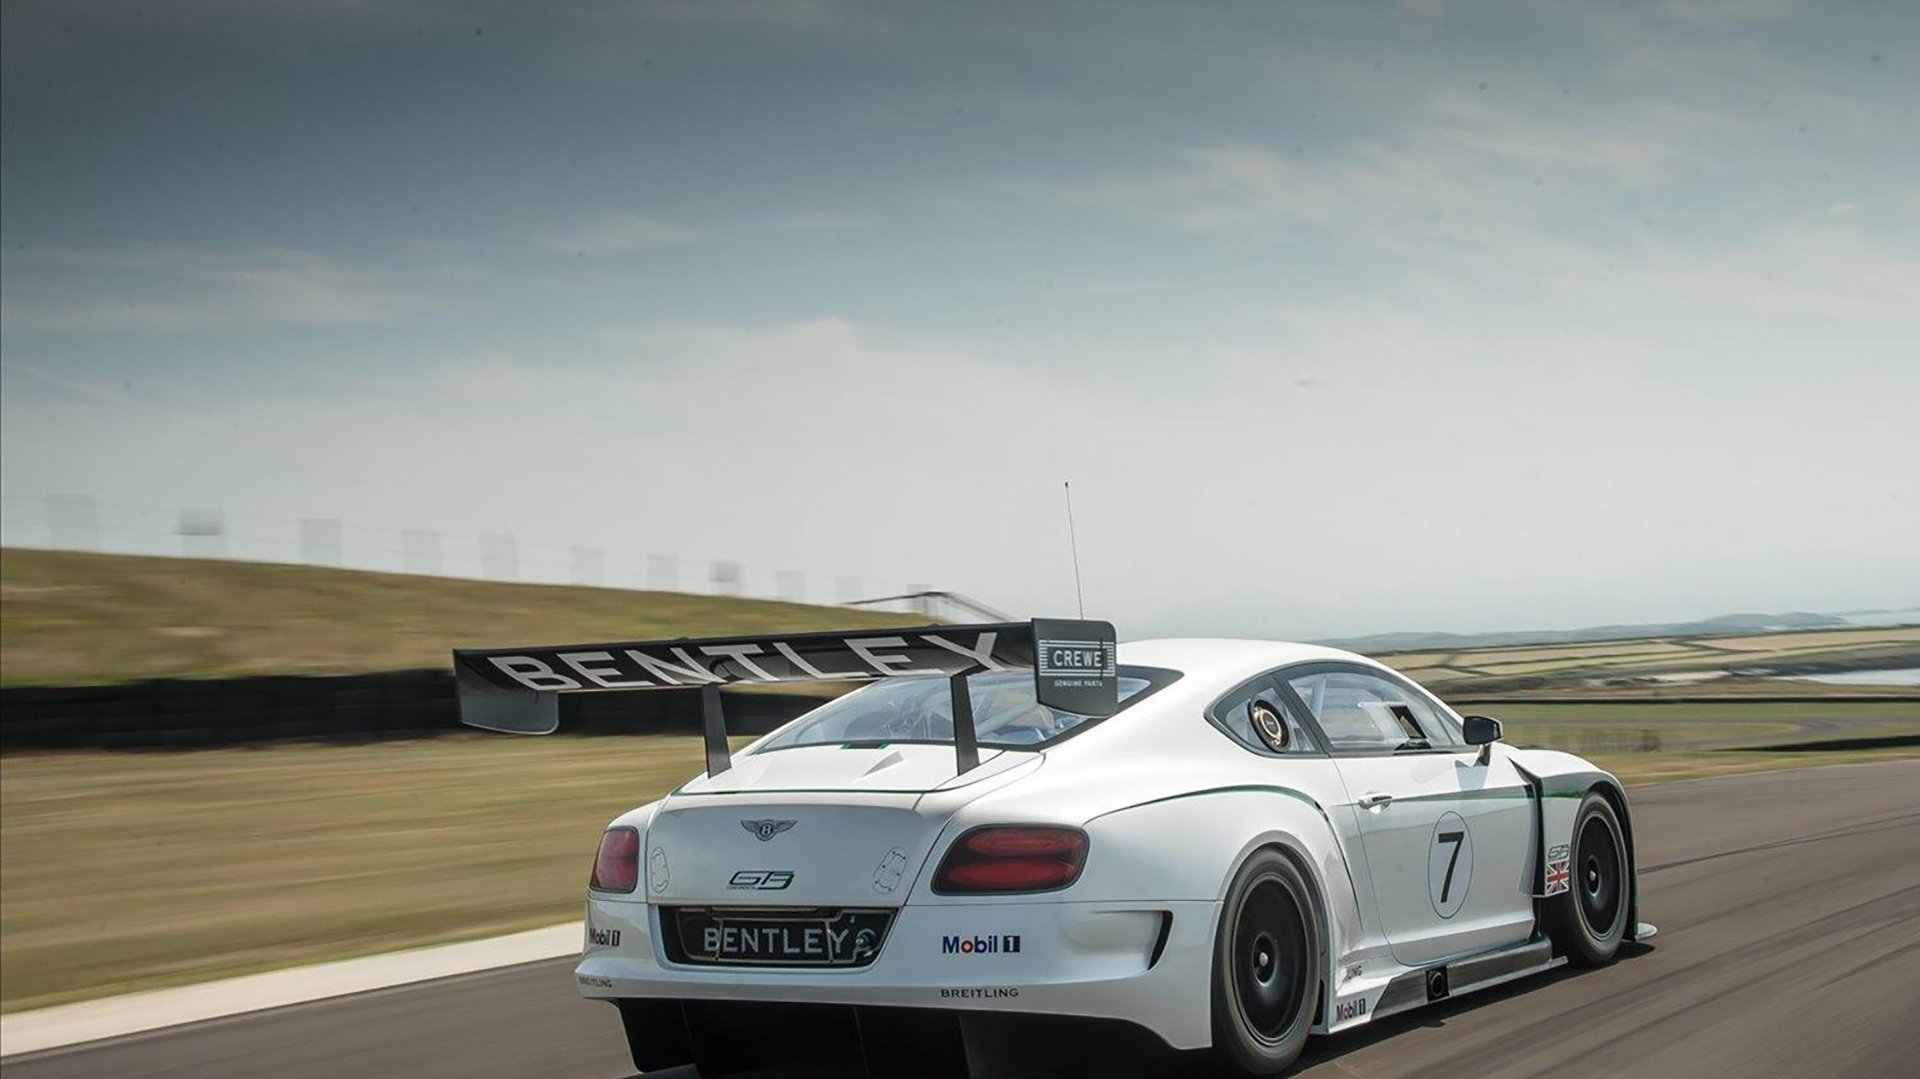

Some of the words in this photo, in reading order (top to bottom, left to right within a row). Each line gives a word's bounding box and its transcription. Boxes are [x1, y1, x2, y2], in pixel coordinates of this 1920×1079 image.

[487, 632, 1005, 690] BENTLEY
[1053, 650, 1102, 667] CREWE
[1438, 831, 1464, 903] 7
[704, 927, 849, 953] BENTLEY
[942, 935, 998, 953] Mobil
[1003, 935, 1020, 953] 1
[941, 988, 1019, 998] BREITLING
[1337, 1000, 1358, 1021] Mobil
